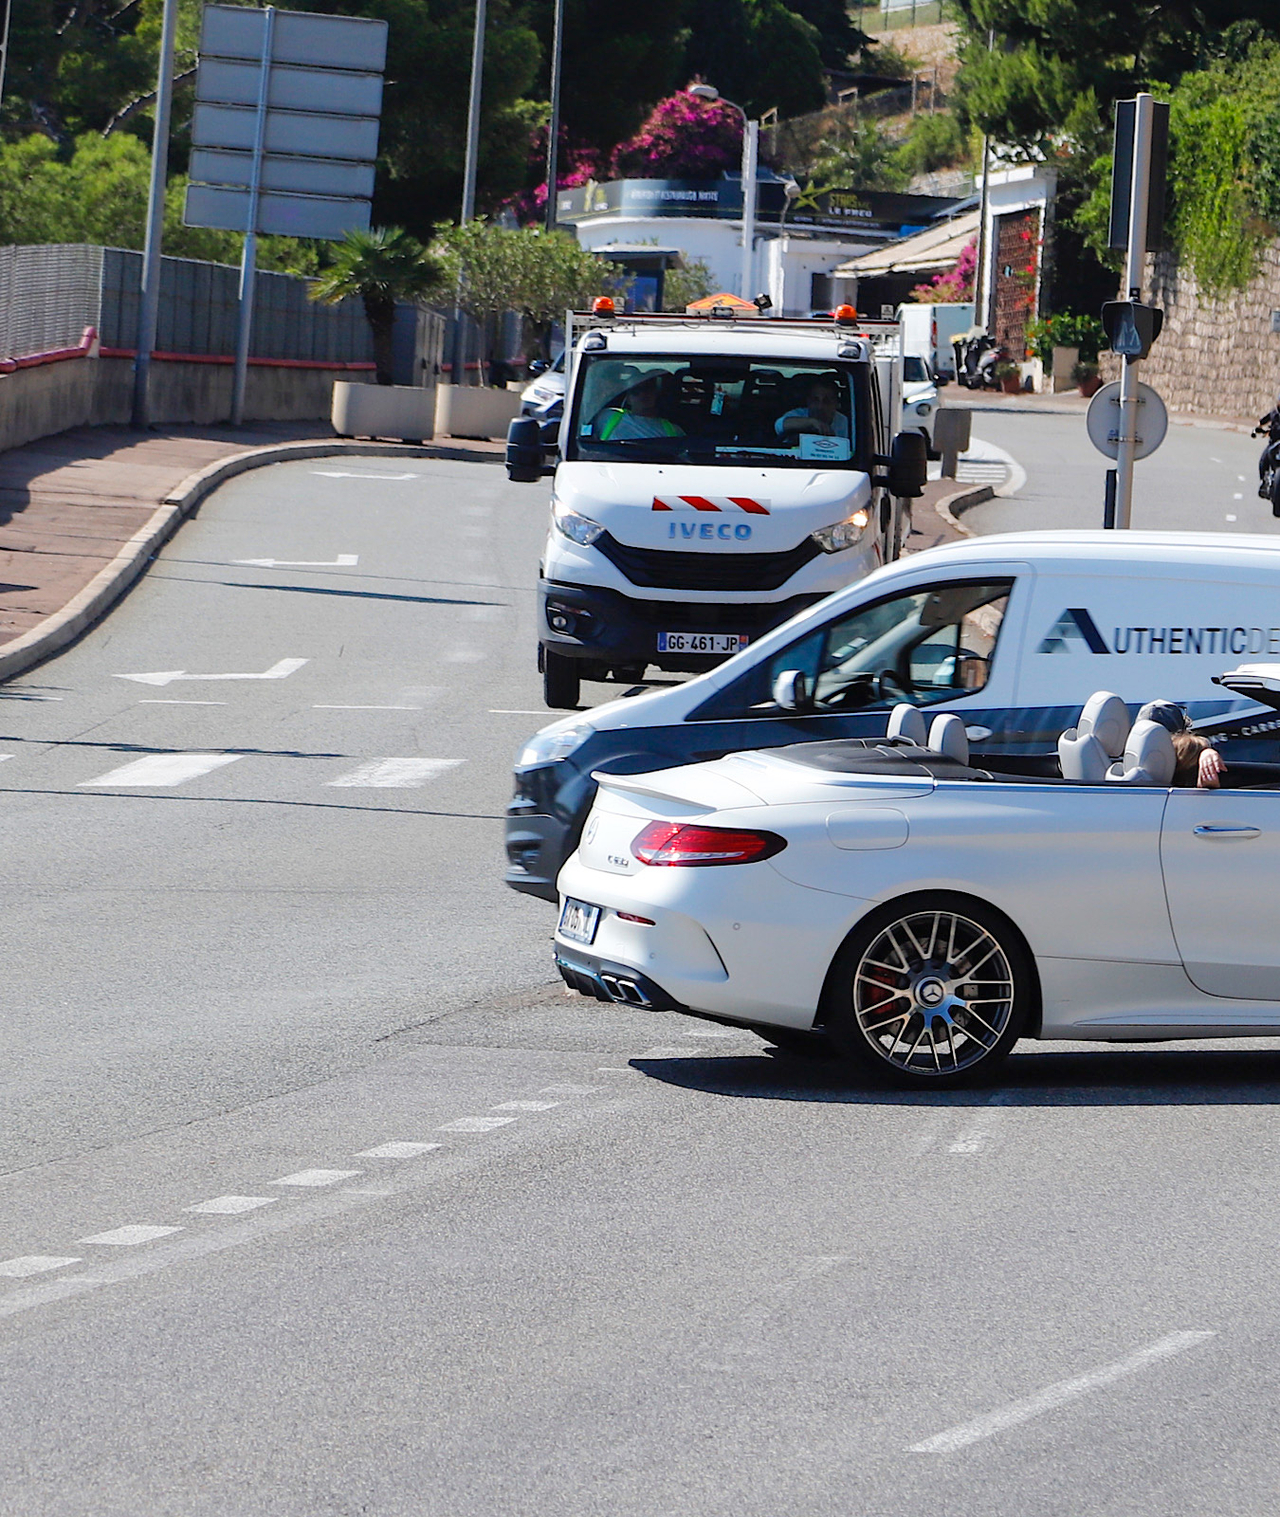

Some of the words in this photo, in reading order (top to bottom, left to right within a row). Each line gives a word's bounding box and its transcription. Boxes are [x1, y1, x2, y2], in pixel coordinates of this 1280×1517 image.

[828, 206, 842, 215] LE
[668, 521, 752, 541] IVECO
[668, 635, 738, 652] GG-461-JP
